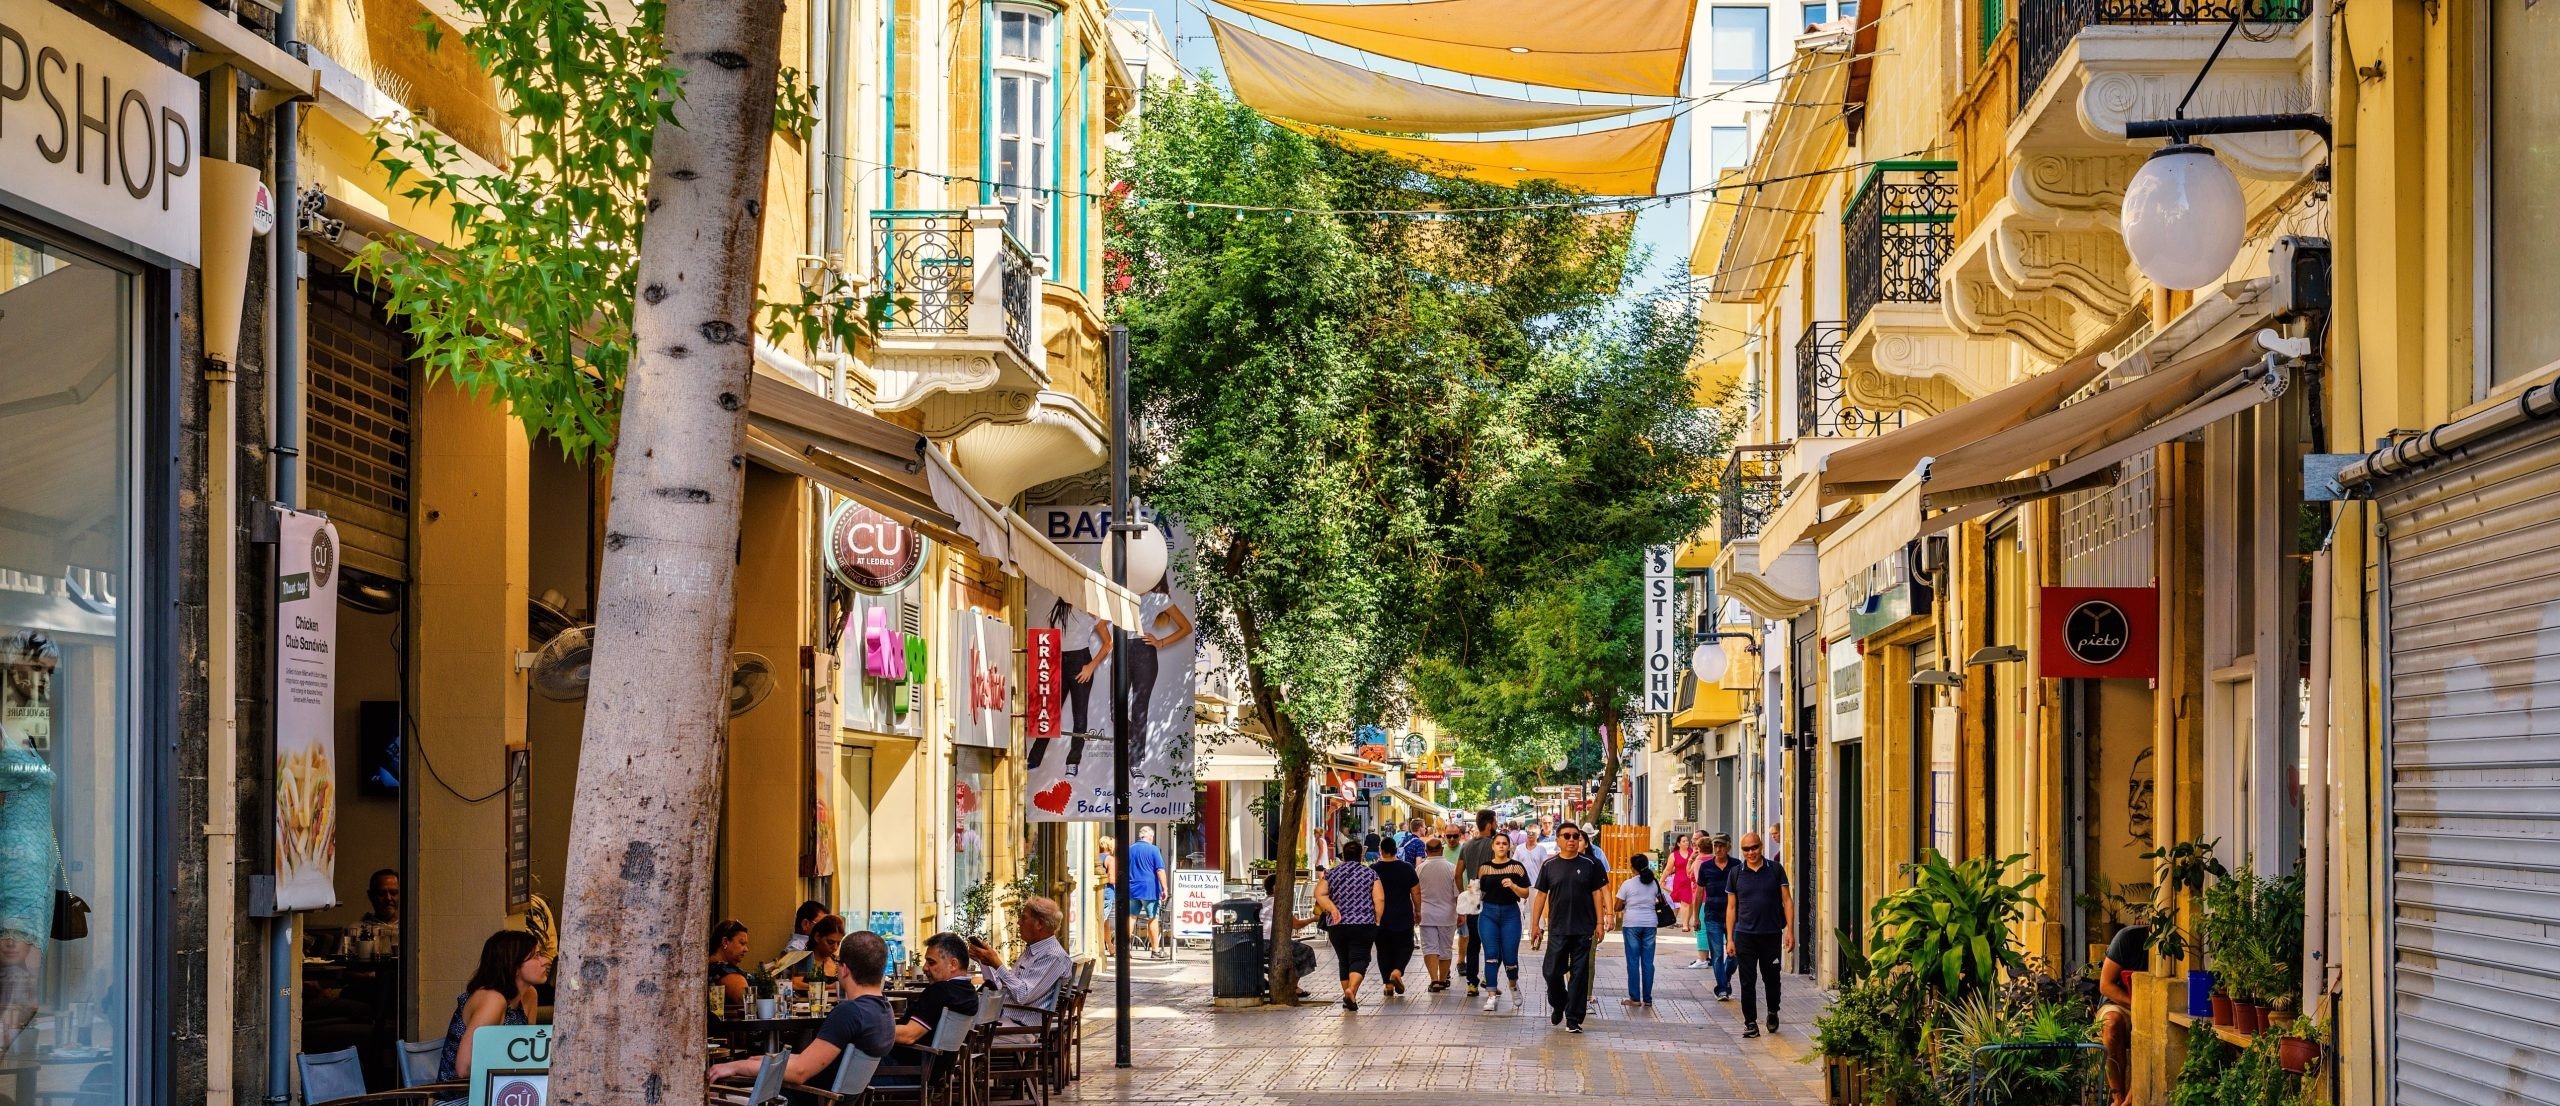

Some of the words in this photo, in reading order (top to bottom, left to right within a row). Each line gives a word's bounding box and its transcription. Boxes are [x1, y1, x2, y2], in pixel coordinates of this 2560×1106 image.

[866, 558, 894, 566] LEDRAS
[838, 557, 863, 582] MEETING
[869, 576, 898, 587] COFFEE
[897, 560, 916, 580] PLACE
[295, 615, 319, 632] Chicken
[285, 634, 300, 649] Club
[300, 637, 329, 653] Sandwich
[2077, 634, 2120, 652] pieto
[1039, 633, 1050, 733] KRASHIAS
[1094, 788, 1114, 797] Bac
[1137, 789, 1169, 799] School
[1077, 800, 1112, 814] Back
[1689, 786, 1697, 820] bamboo
[1178, 874, 1218, 882] METAXA
[1189, 891, 1206, 899] ALL
[1183, 900, 1213, 909] SILVER
